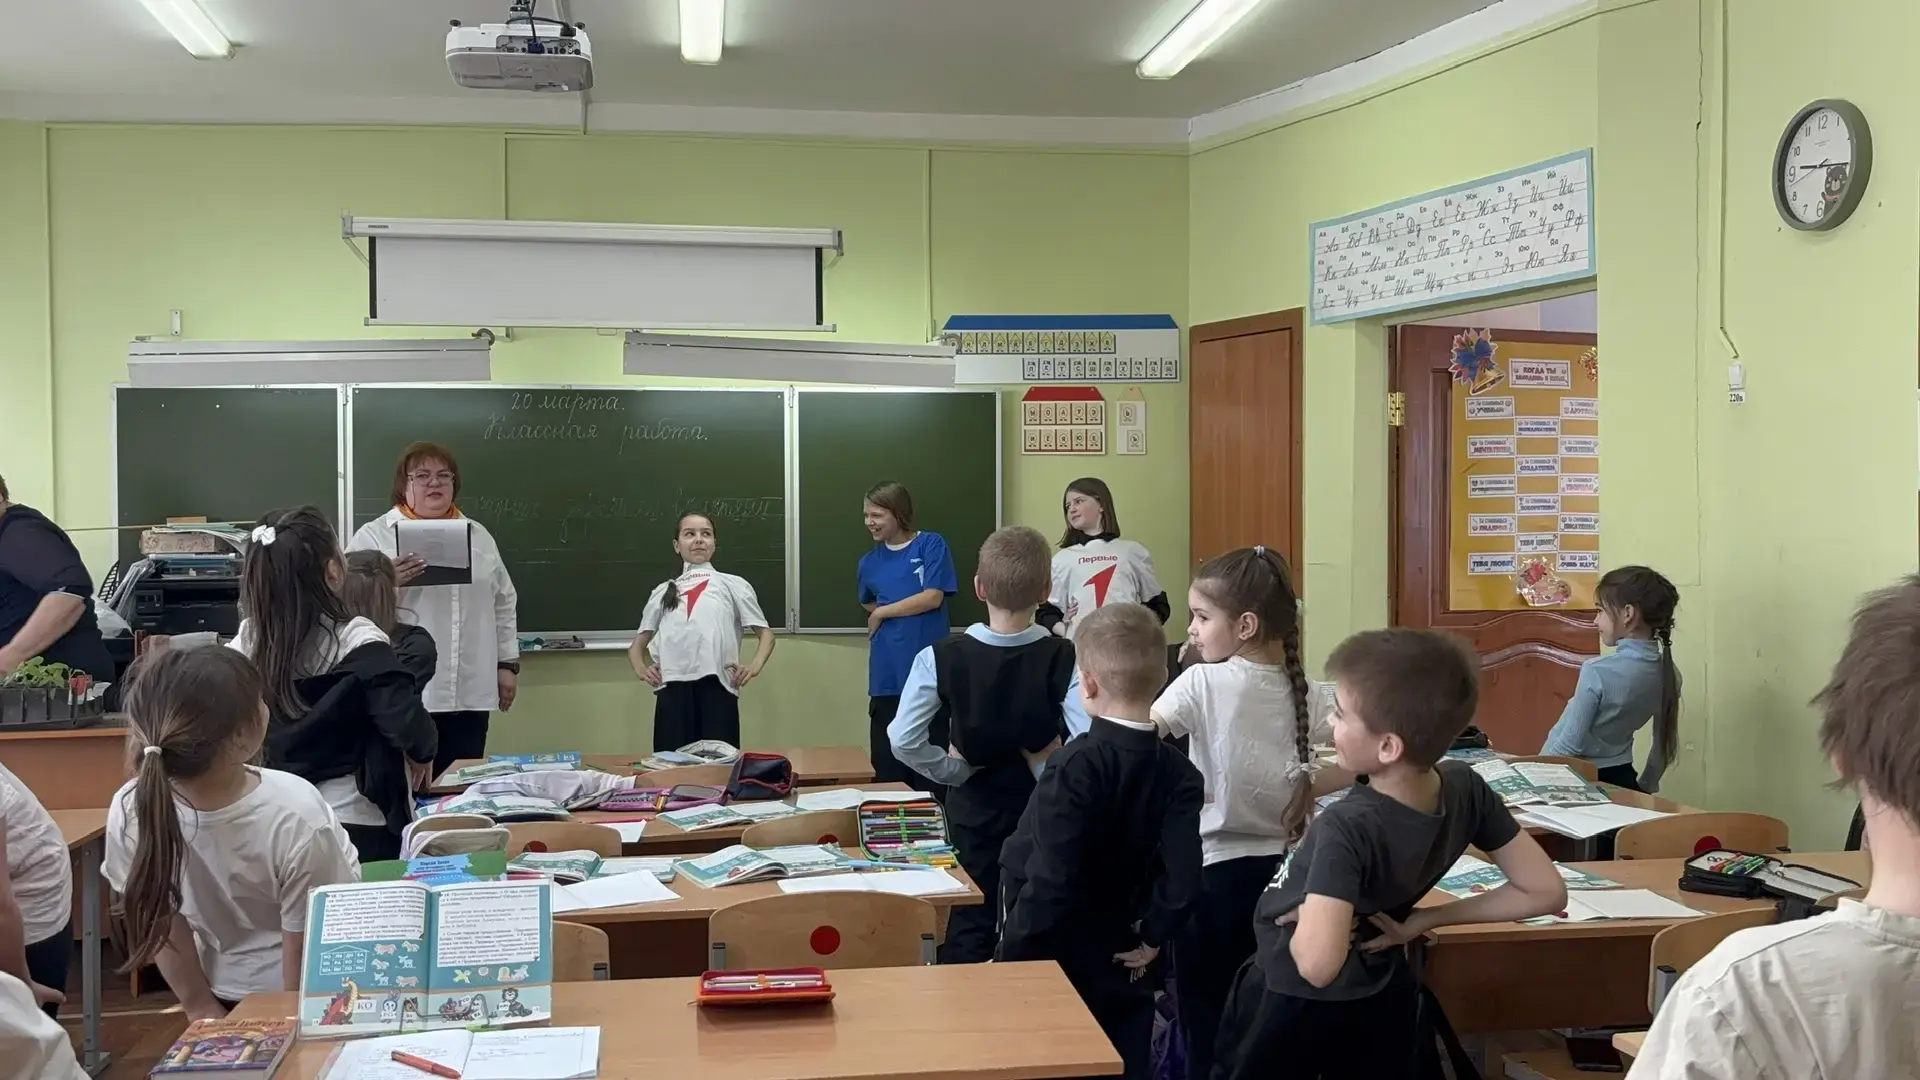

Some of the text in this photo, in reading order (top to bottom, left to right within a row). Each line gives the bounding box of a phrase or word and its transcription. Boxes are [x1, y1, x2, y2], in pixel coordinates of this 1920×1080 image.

[1818, 115, 1827, 130] 12
[1837, 116, 1840, 126] 1
[1805, 126, 1810, 137] 11
[1794, 146, 1800, 156] 10
[1789, 166, 1795, 182] 9
[1792, 192, 1797, 201] 8
[1803, 204, 1808, 215] 7
[1817, 201, 1823, 217] 6
[511, 392, 625, 424] 20 марта.
[484, 411, 708, 456] Классная работа.
[1078, 556, 1118, 564] Первые
